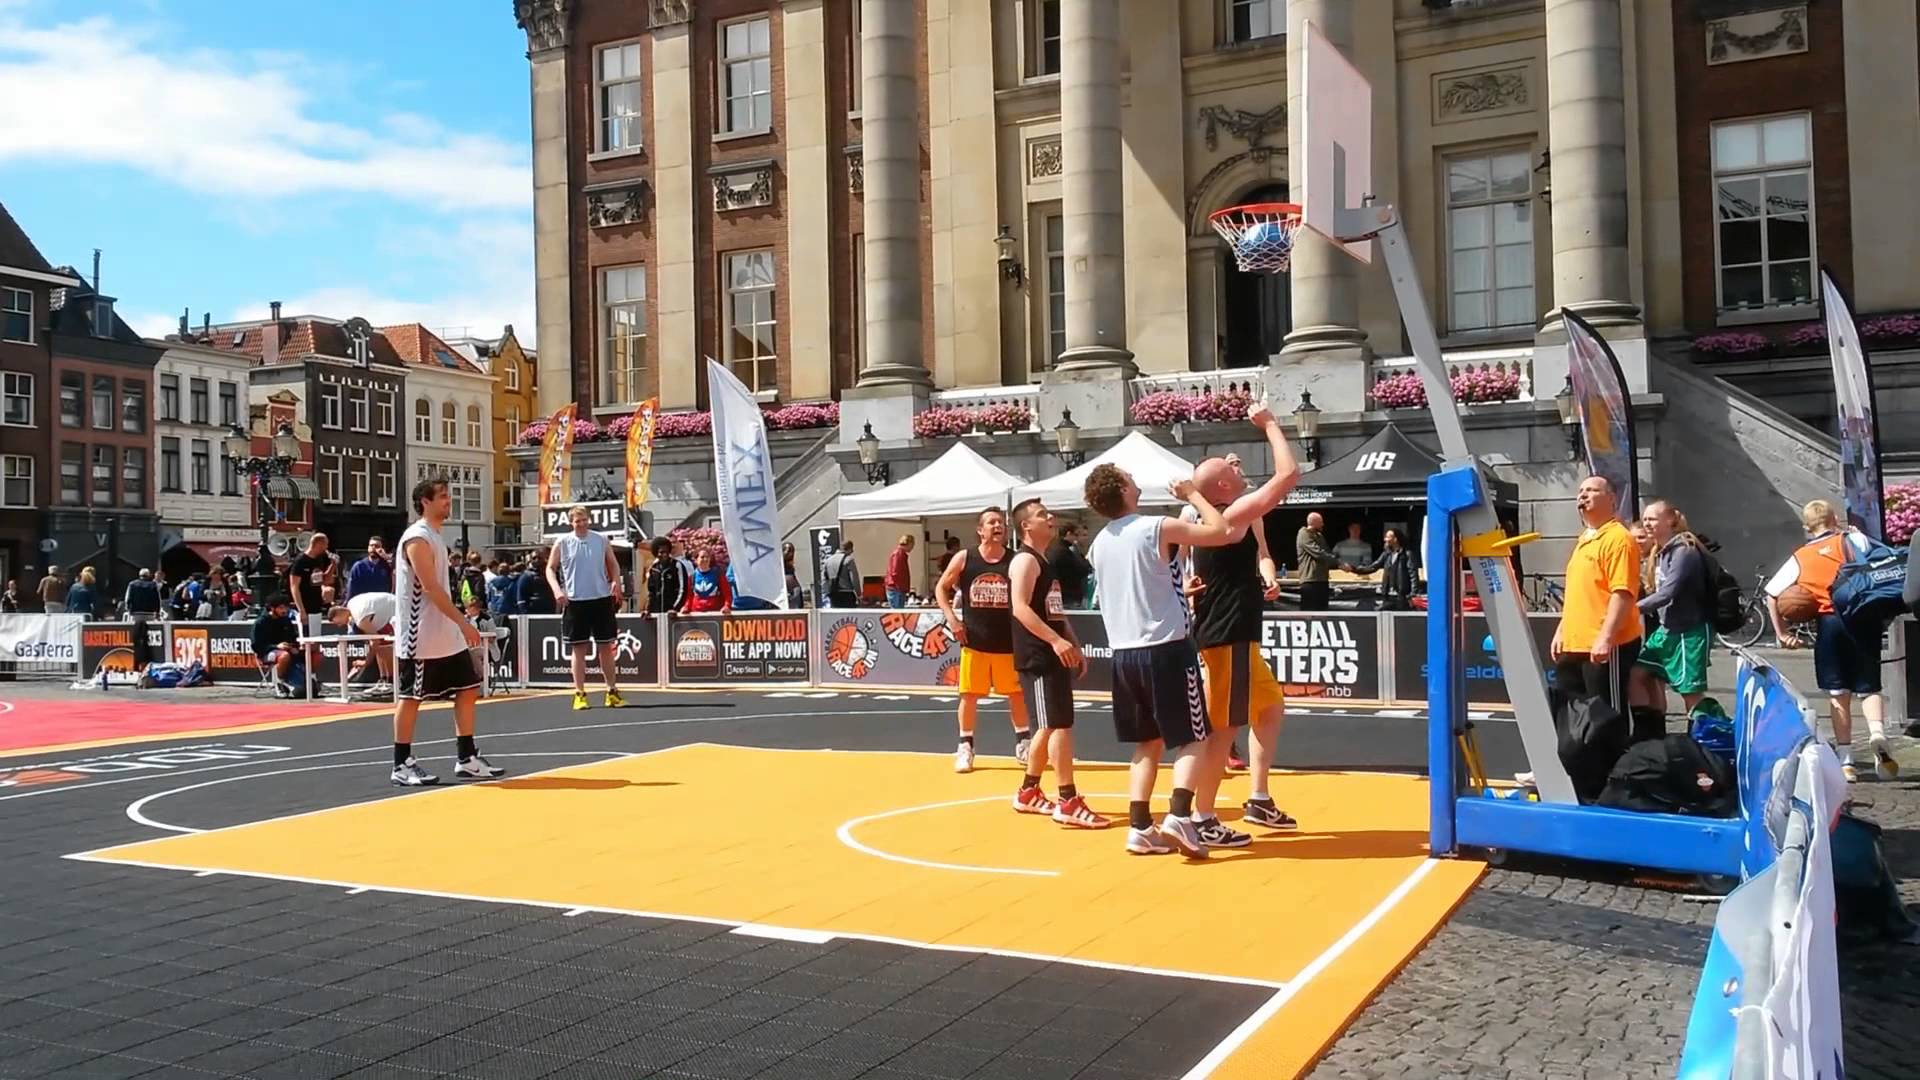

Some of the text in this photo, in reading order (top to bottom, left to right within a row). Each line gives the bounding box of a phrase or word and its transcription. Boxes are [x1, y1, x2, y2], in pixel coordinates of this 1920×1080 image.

[548, 508, 620, 527] PATJE
[723, 619, 806, 641] DOWNLOAD
[1261, 621, 1357, 647] ETBALL
[15, 640, 74, 657] GasTerra
[175, 637, 208, 670] 3X3
[211, 638, 254, 653] BASKETB
[723, 643, 746, 659] THE
[748, 642, 771, 659] APP
[775, 641, 806, 659] NOW!
[826, 648, 879, 679] RACE4FUN
[1326, 686, 1352, 697] nbb
